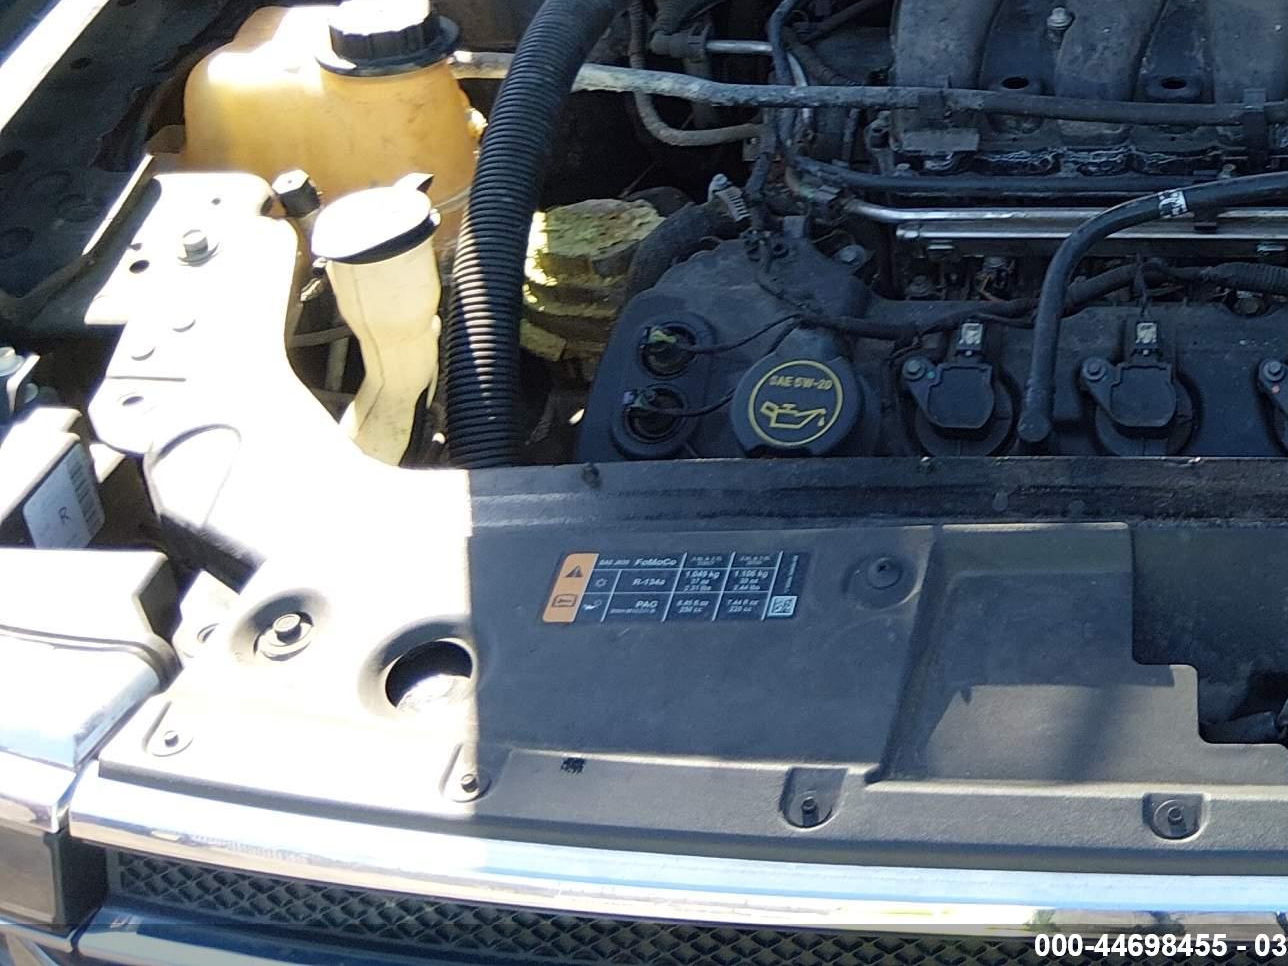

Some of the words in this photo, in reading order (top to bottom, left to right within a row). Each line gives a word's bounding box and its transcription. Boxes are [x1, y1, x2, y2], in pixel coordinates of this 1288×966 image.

[769, 375, 793, 387] SAE
[794, 377, 832, 390] 5W-20
[633, 558, 677, 566] FoMoCo
[635, 600, 659, 608] PAG
